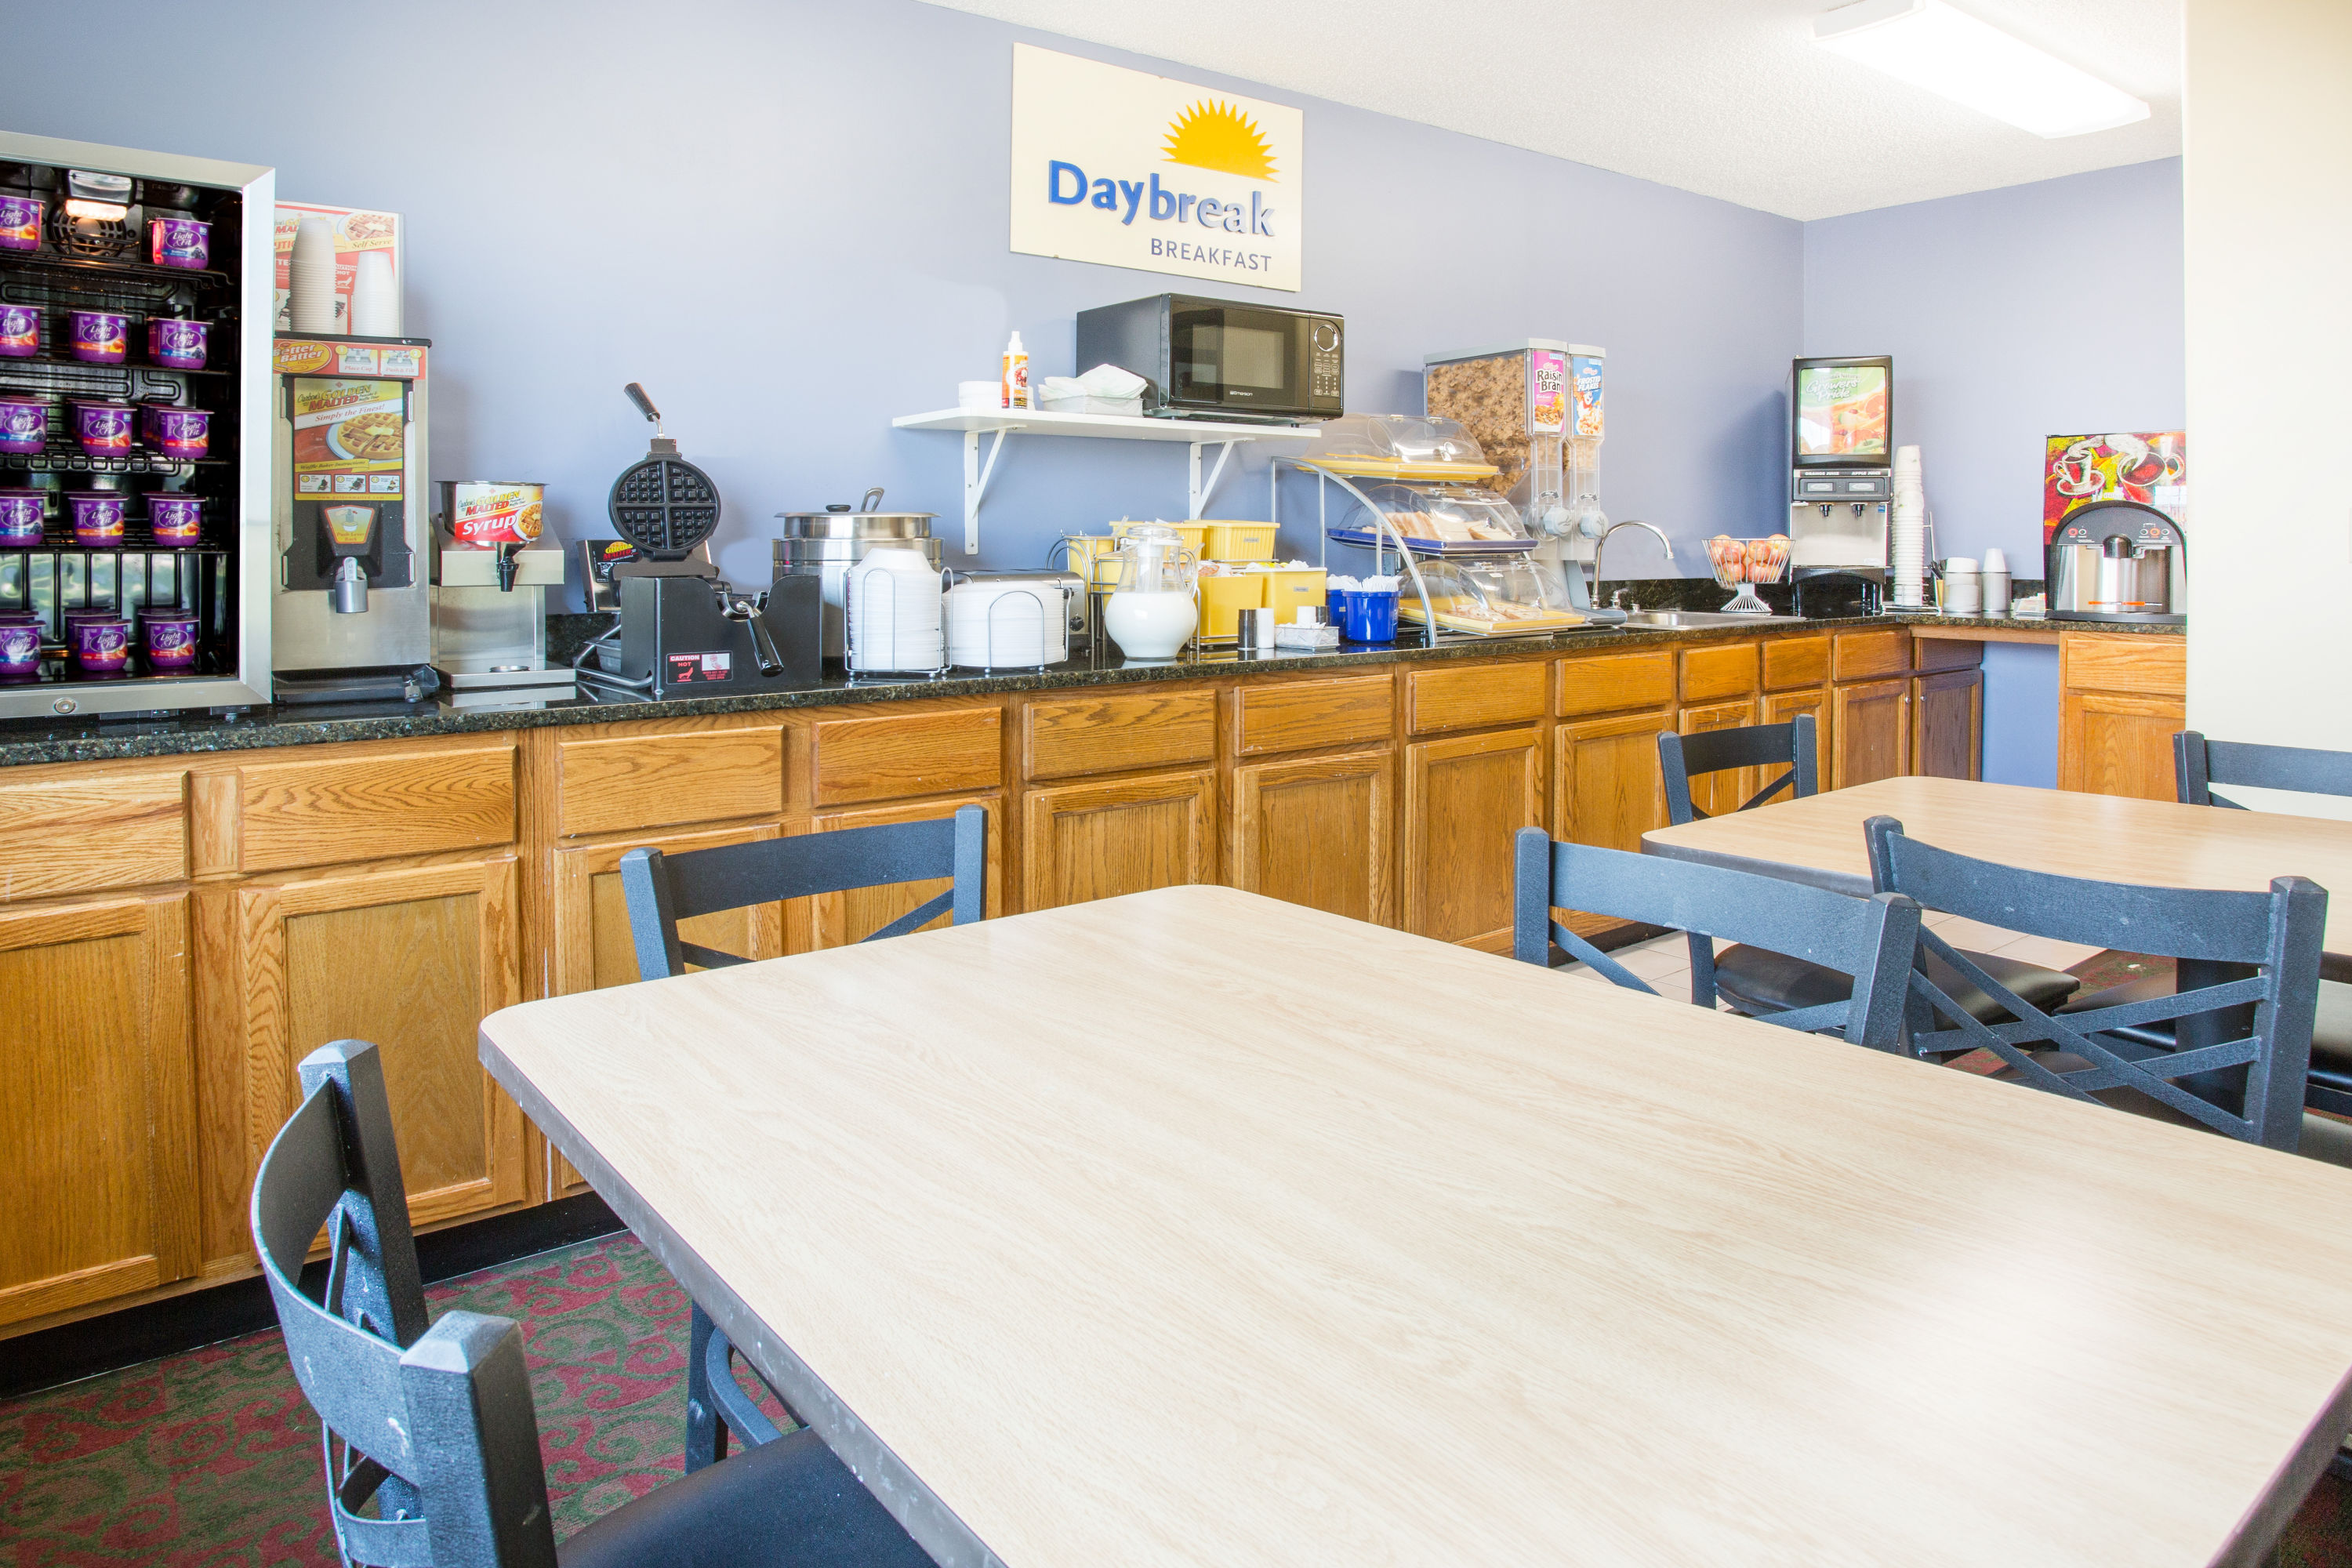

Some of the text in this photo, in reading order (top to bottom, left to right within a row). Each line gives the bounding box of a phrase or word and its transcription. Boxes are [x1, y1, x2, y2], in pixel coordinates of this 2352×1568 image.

[1048, 159, 1276, 237] Daybreak
[0, 209, 24, 220] Light
[172, 231, 194, 241] Light
[352, 241, 368, 249] Self
[1150, 238, 1272, 272] BREAKFAST
[281, 350, 323, 362] Batter
[1537, 369, 1563, 383] Raisin
[1577, 376, 1601, 385] FROSTED
[1541, 380, 1561, 392] Bran
[1577, 382, 1600, 392] FLAKES
[321, 384, 372, 401] GOLDEN
[1817, 388, 1850, 402] Pride
[309, 394, 358, 412] MALTED
[315, 412, 343, 422] Simply
[360, 404, 385, 414] Finest!
[96, 420, 118, 431] Light
[477, 490, 521, 506] GOLDEN
[465, 500, 510, 517] MALTED
[165, 510, 186, 521] Light
[462, 514, 516, 535] Syrup
[97, 633, 118, 644] Light
[160, 632, 181, 642] Light
